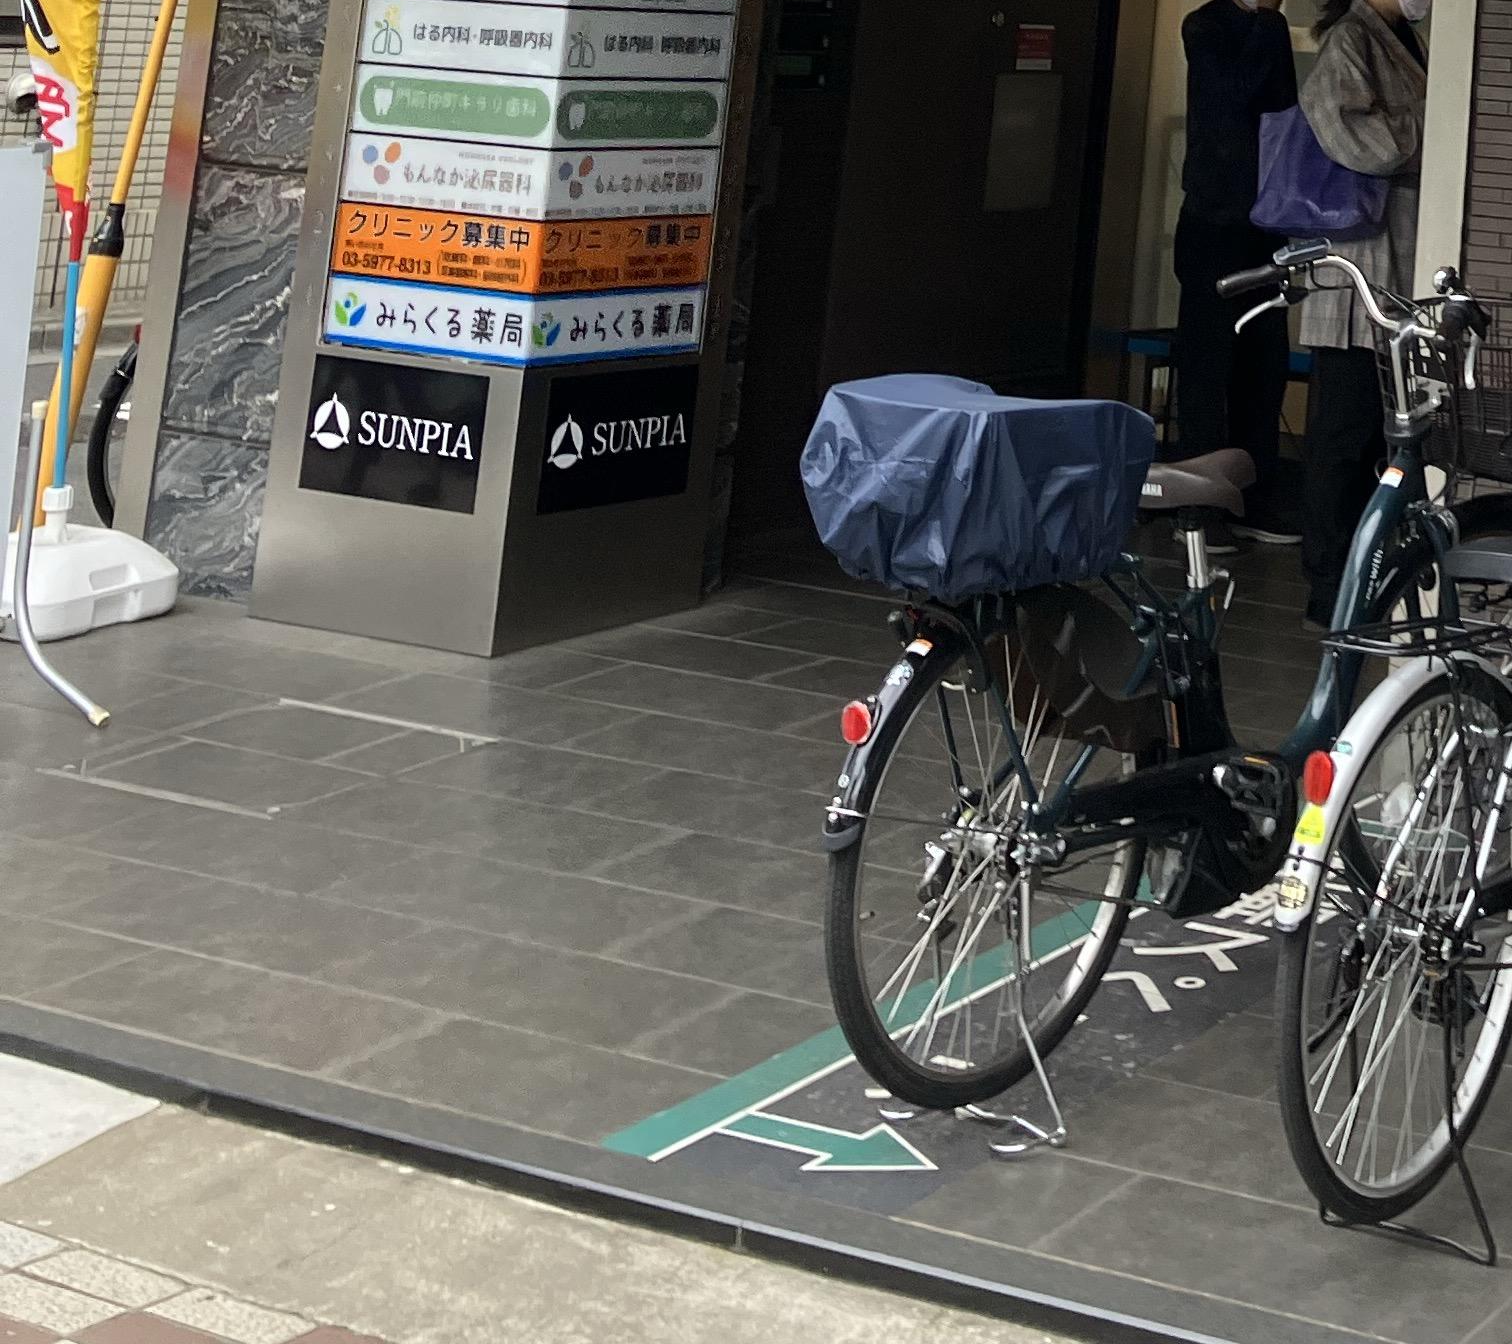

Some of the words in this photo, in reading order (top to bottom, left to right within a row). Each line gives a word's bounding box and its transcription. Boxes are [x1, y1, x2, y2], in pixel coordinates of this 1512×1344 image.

[349, 209, 530, 252] クリニック募集中
[342, 250, 431, 276] 03-5977-8313
[376, 301, 524, 348] みらくる薬局
[358, 410, 473, 460] SUNPIA
[591, 413, 687, 456] SUNPIA
